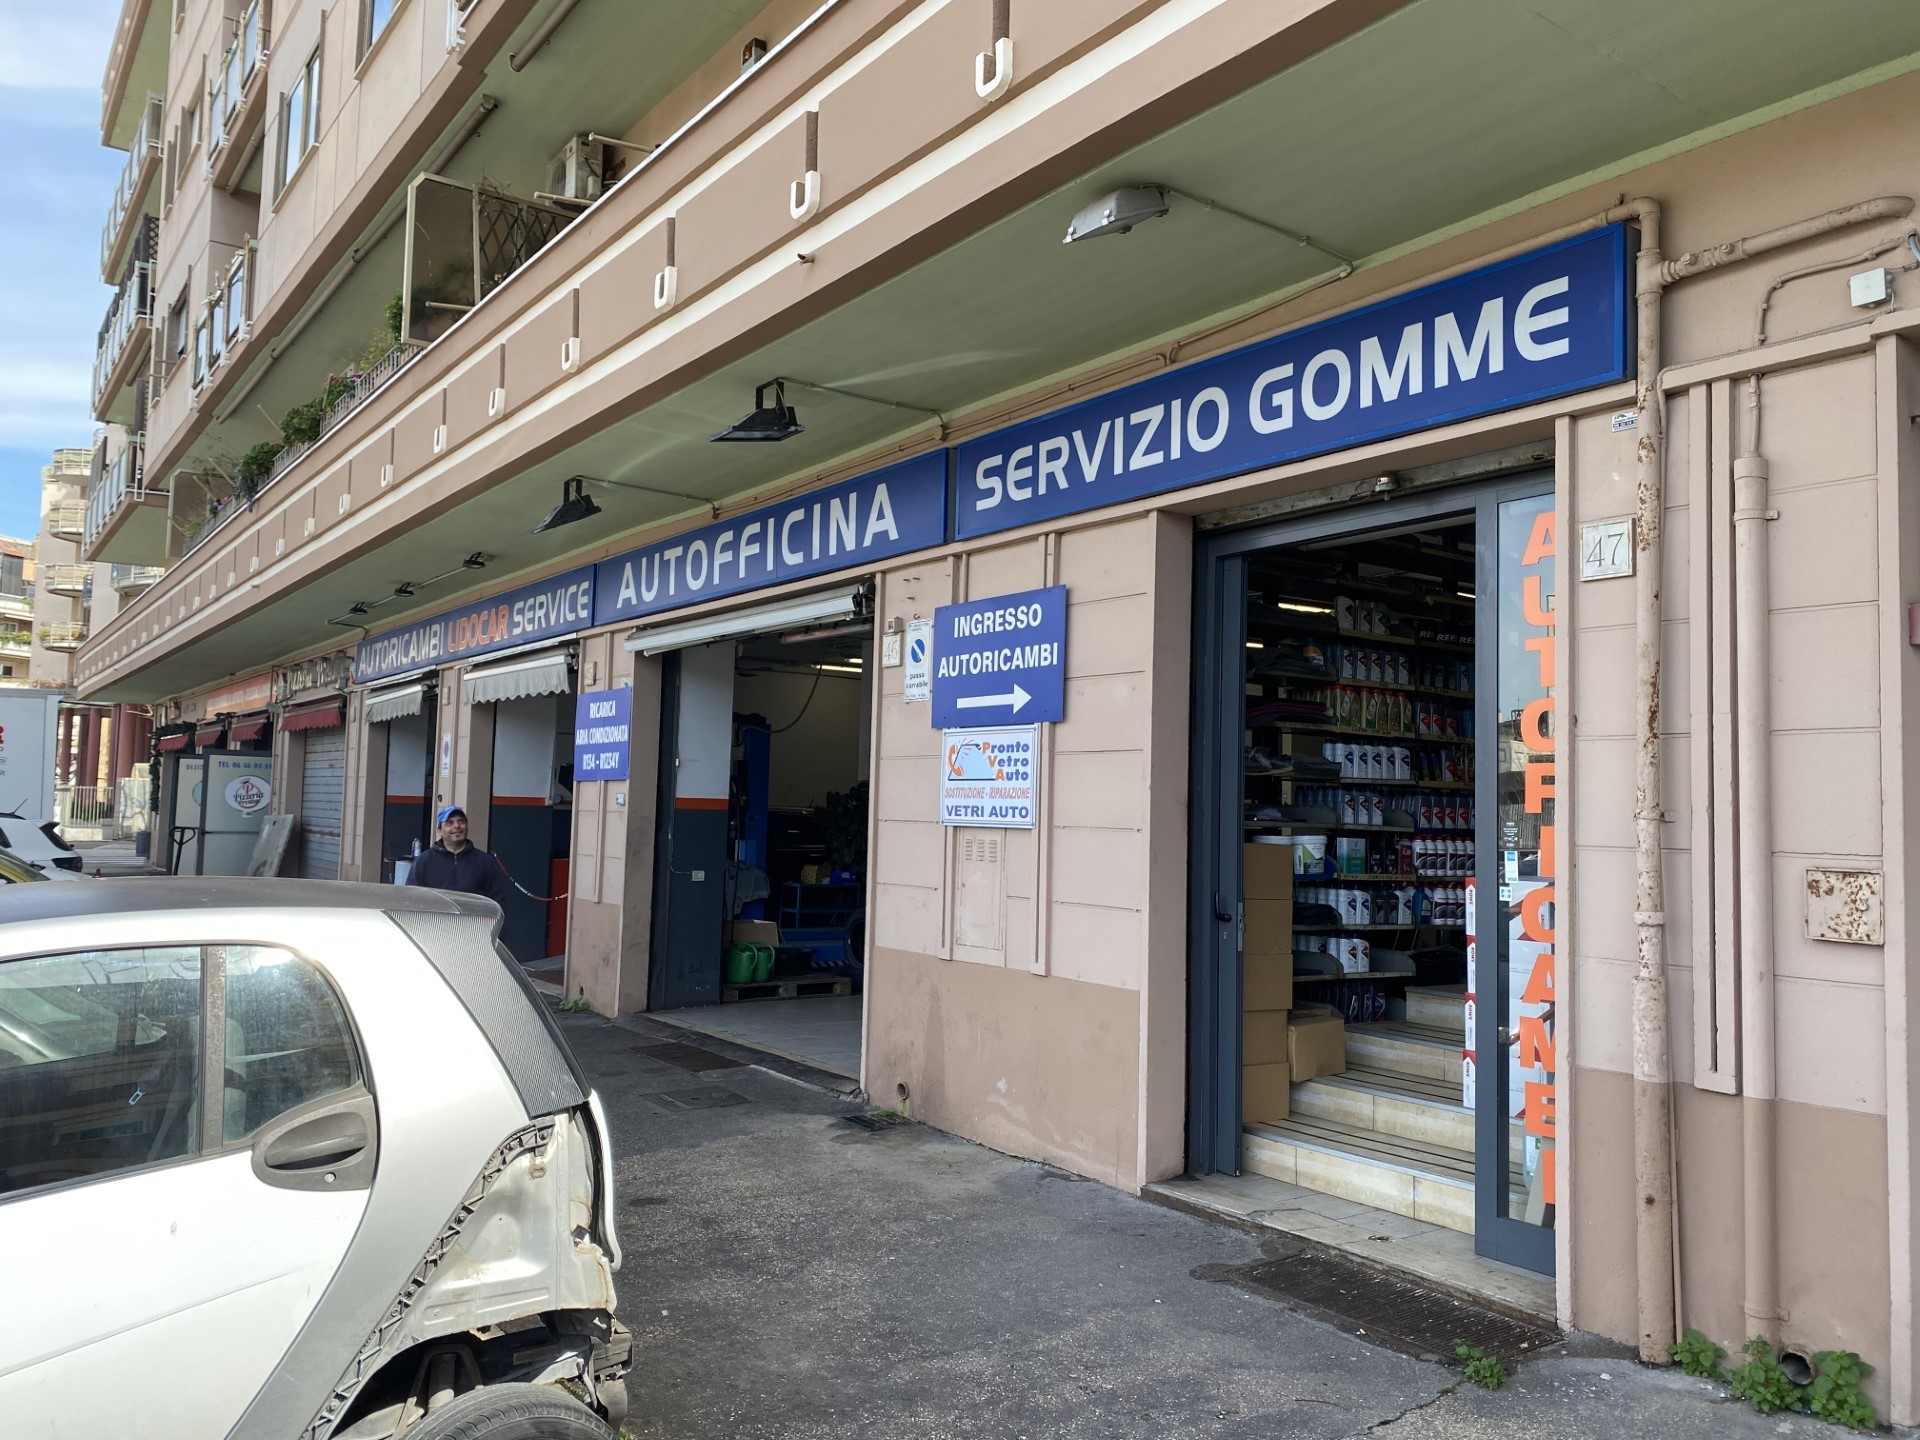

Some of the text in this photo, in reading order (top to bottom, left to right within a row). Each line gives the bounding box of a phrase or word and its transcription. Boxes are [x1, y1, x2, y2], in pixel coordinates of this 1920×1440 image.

[975, 275, 1570, 511] SERVIZIO GOMME
[616, 482, 899, 609] AUTOFFICINA
[1586, 532, 1625, 568] 47
[357, 581, 590, 677] AUTORICAMBI LIDOCAR SERVICE
[954, 603, 1043, 638] INGRESSO
[884, 639, 899, 661] 46
[938, 642, 1058, 679] AUTORICAMBI
[906, 680, 929, 689] carrabile
[909, 672, 926, 681] passo
[589, 700, 616, 719] RICARICA
[576, 724, 628, 746] ARIA CONDIZIONATA
[982, 741, 1029, 754] Pronto
[987, 755, 1029, 768] Vetro
[995, 768, 1029, 781] Auto
[233, 791, 263, 802] Pizzeria
[944, 786, 985, 799] SOSTITUZIONE
[989, 786, 1031, 799] RIPARAZIONE
[946, 805, 1029, 819] VETRI AUTO
